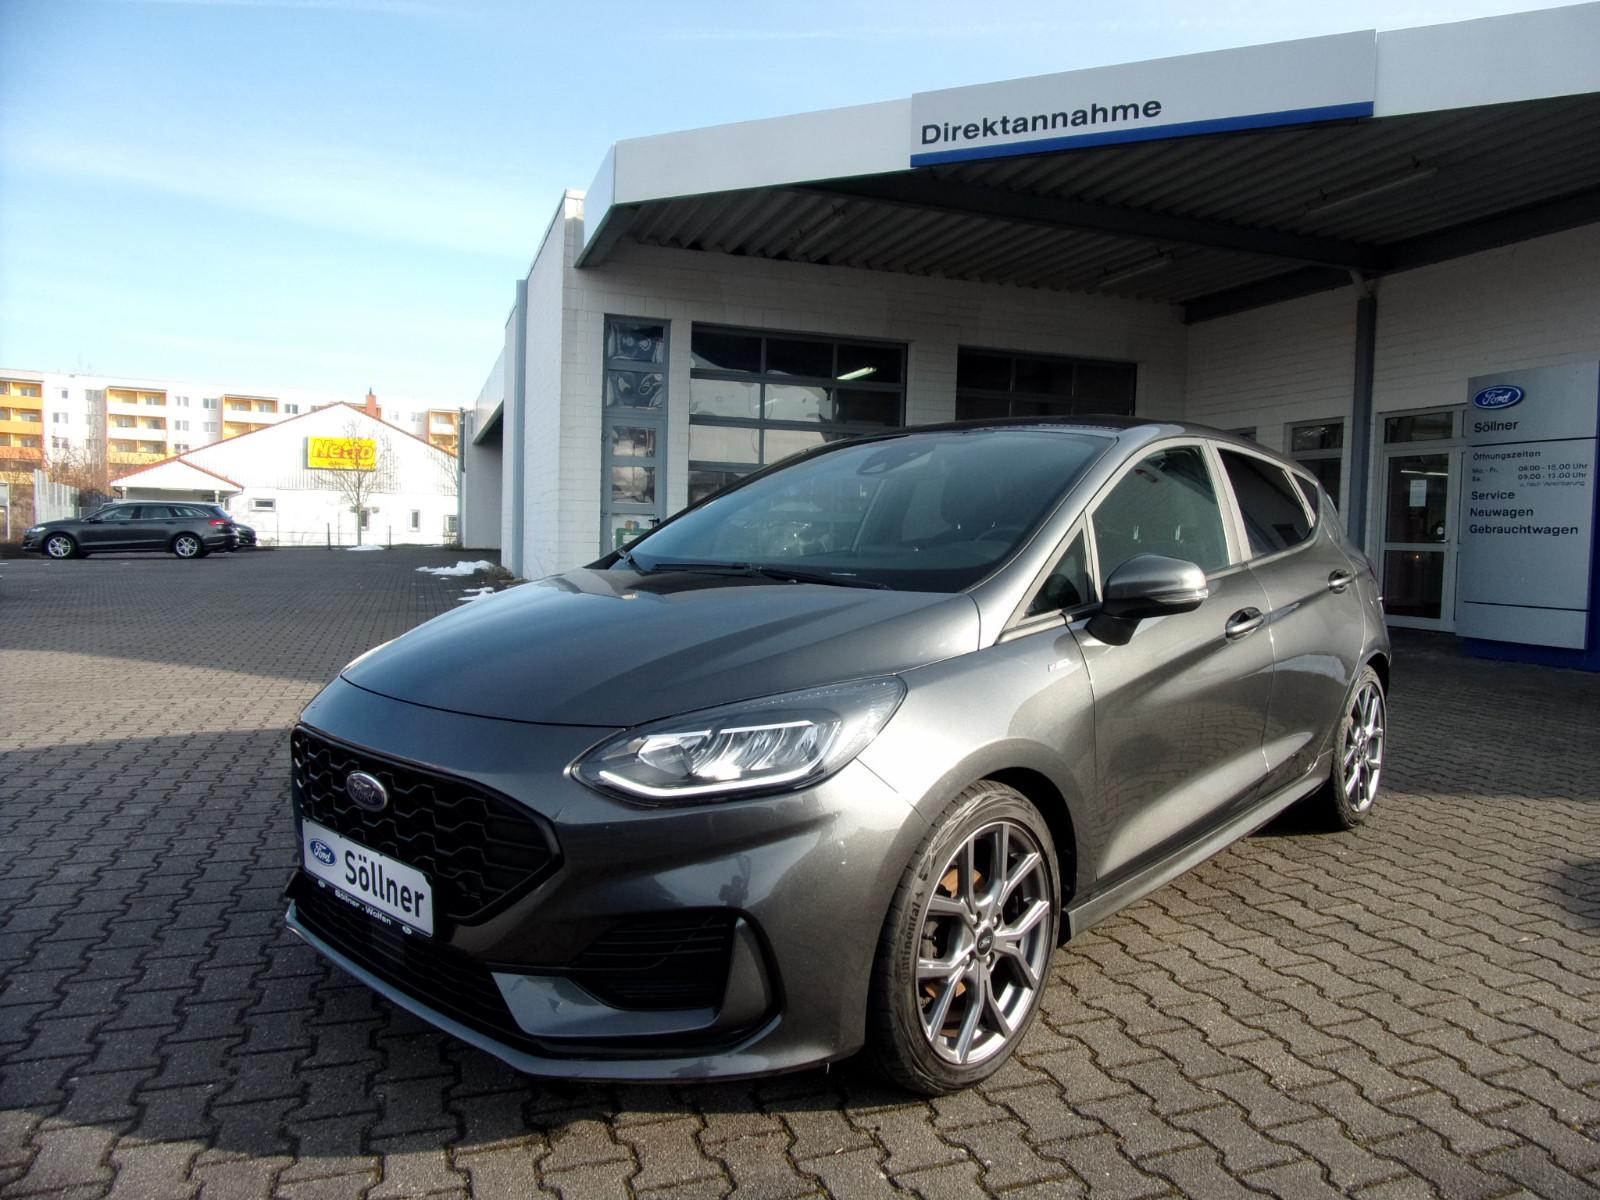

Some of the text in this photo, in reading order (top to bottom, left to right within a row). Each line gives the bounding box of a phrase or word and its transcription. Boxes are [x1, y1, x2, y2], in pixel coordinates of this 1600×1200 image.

[921, 100, 1162, 145] Direktannahme
[1474, 421, 1519, 433] Söllner
[312, 438, 374, 460] Netto
[1572, 462, 1588, 470] Uhr
[1572, 471, 1587, 479] Uhr
[1471, 490, 1516, 501] Service
[1470, 507, 1534, 519] Neuwagen
[1469, 524, 1579, 537] Gebrauchtwagen
[345, 850, 425, 918] Söllner
